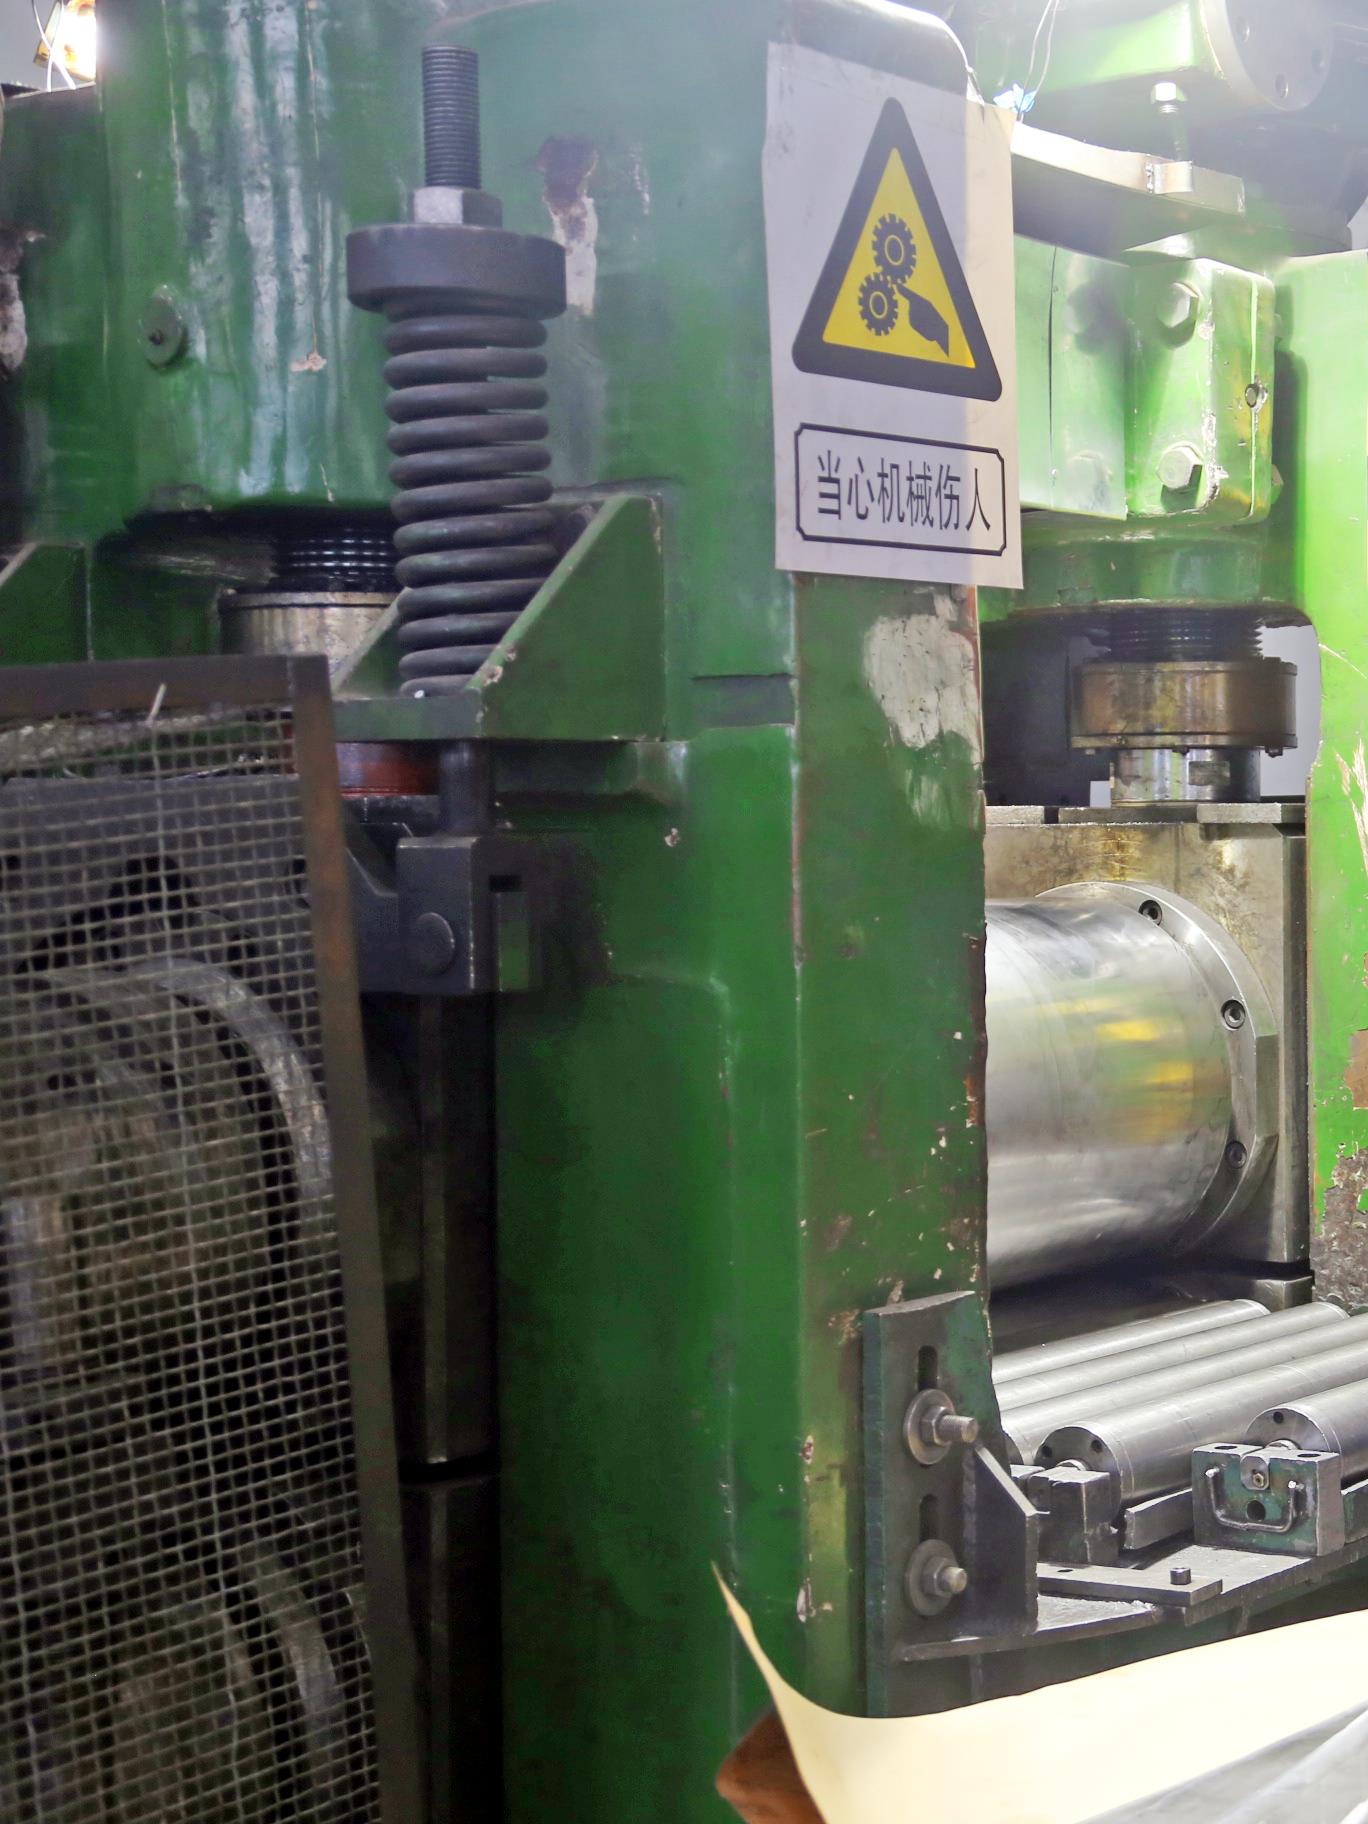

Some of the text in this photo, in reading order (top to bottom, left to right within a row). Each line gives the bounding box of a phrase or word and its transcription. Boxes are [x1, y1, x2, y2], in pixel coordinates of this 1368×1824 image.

[816, 449, 992, 532] 当心机械伤人
